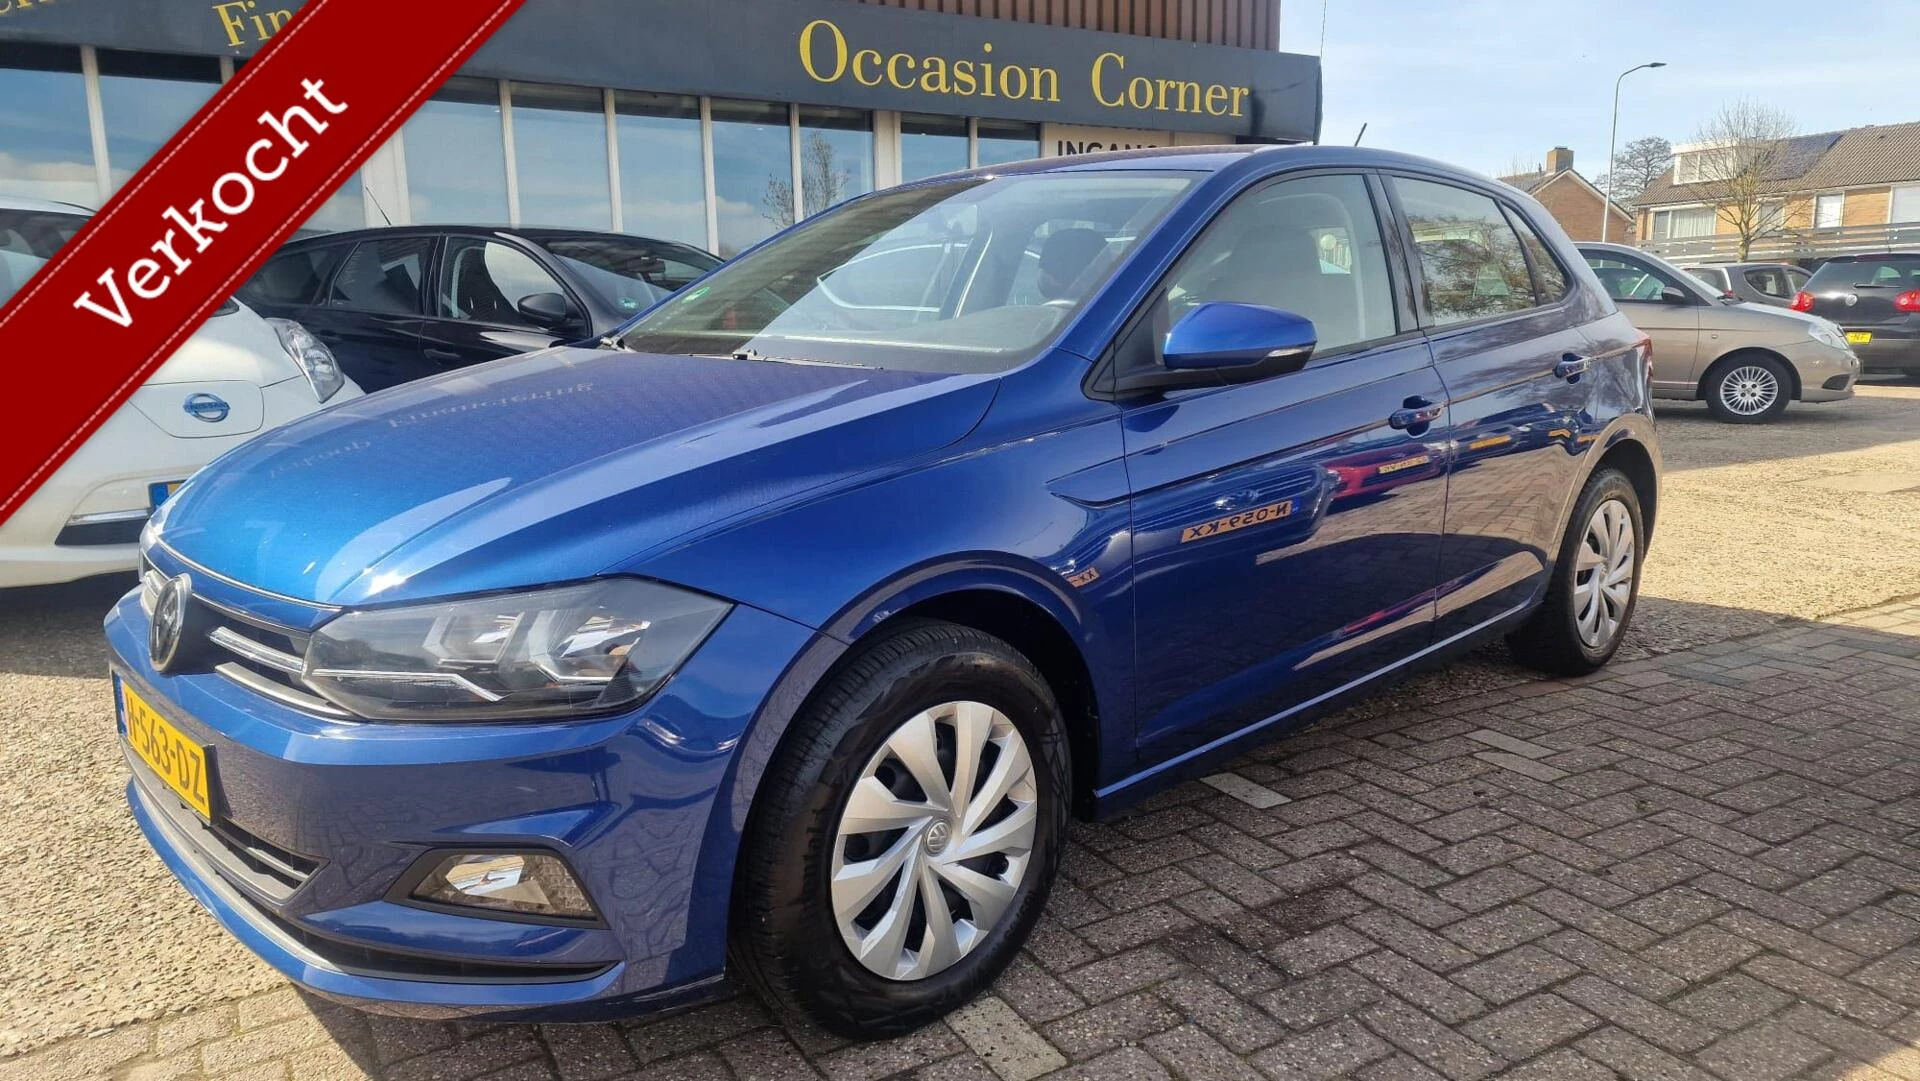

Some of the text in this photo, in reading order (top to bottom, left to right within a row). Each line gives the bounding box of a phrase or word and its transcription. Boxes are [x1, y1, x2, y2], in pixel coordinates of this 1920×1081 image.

[212, 0, 294, 47] Fin
[799, 19, 1249, 117] Occasion Corner
[125, 692, 206, 806] H-563-DZ
